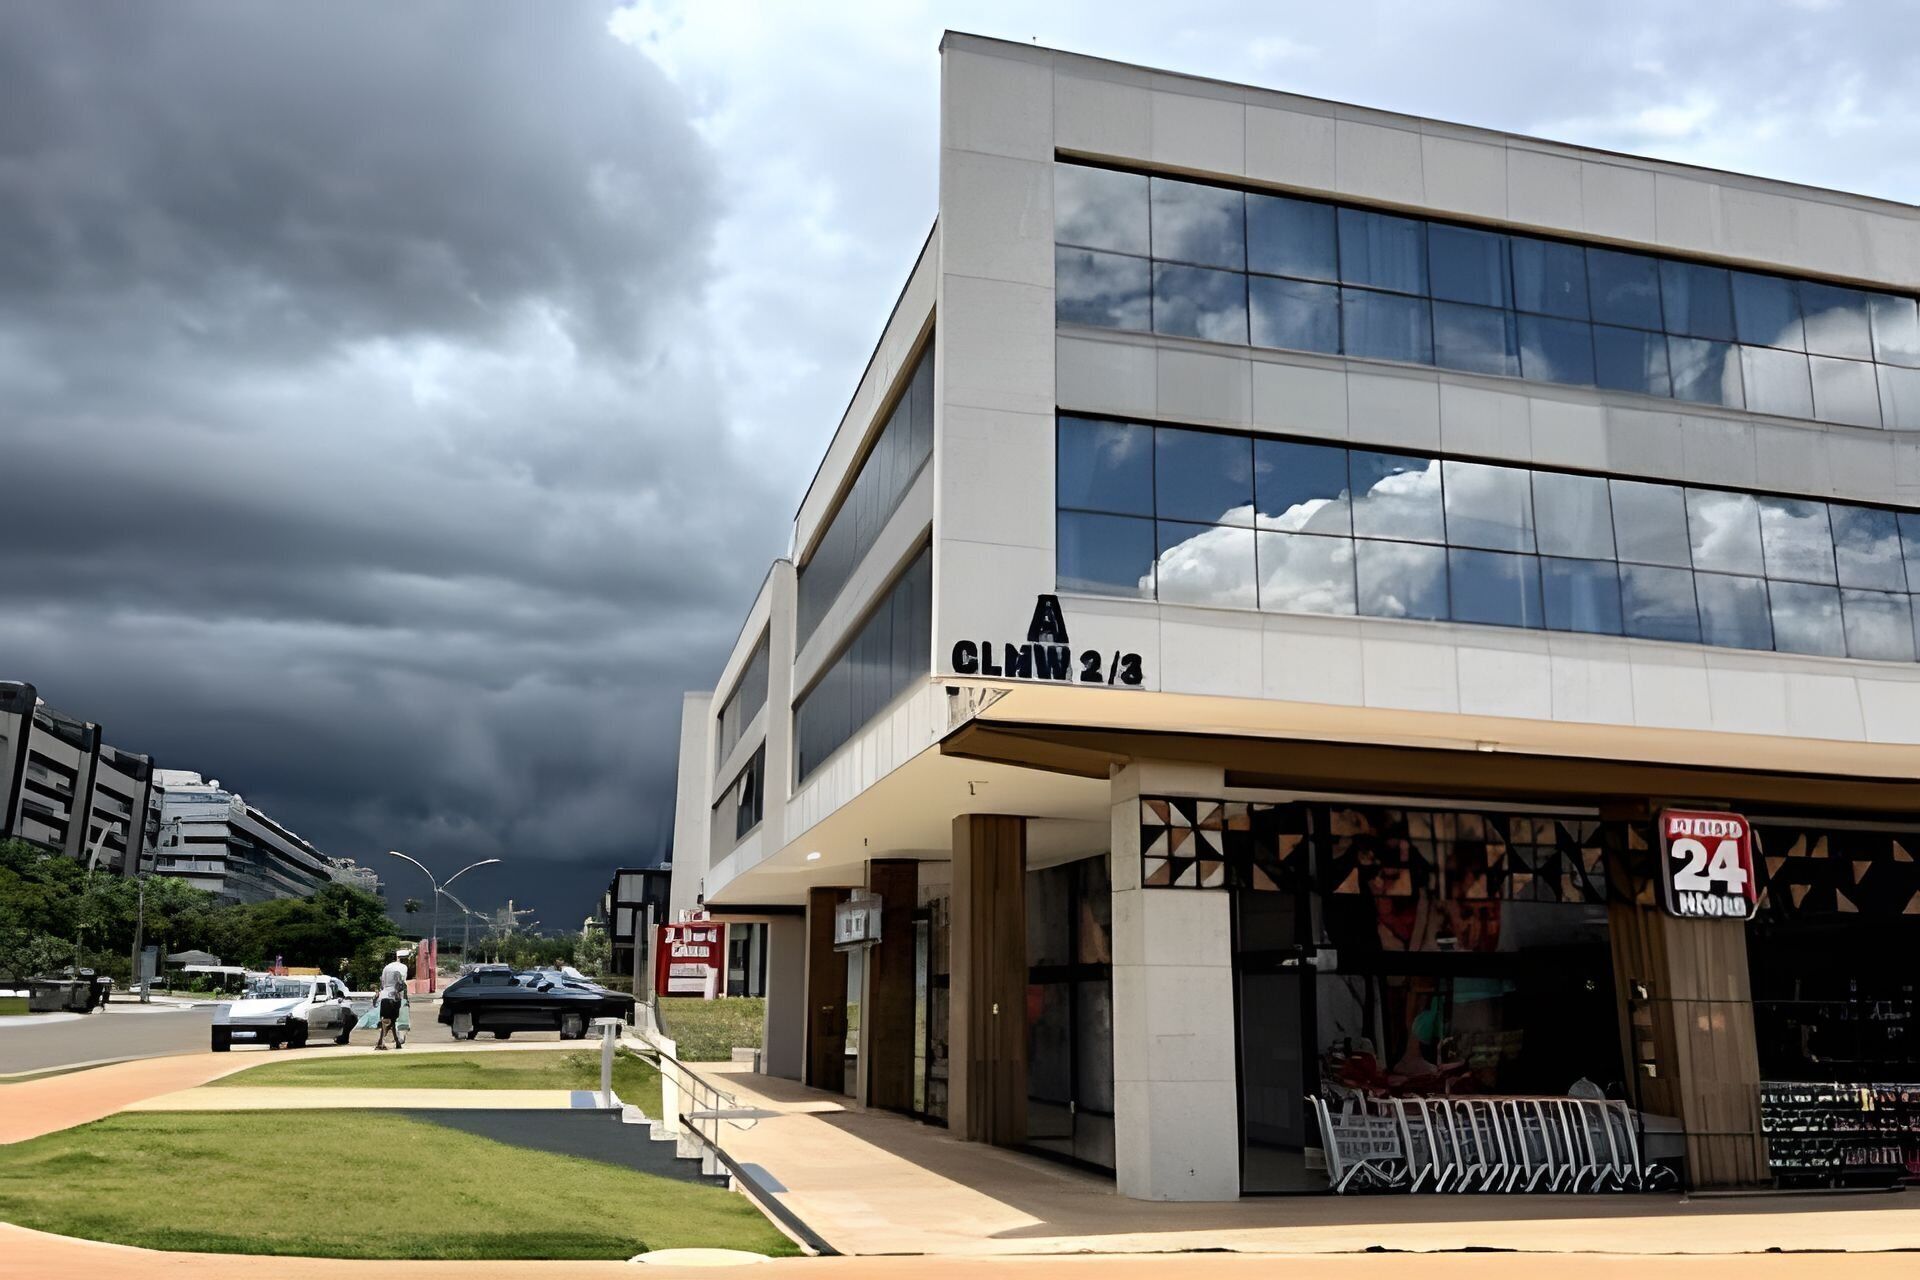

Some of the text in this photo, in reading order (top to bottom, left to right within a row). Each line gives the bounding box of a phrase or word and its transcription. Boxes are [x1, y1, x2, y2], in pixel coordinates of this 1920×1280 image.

[1027, 594, 1069, 643] A
[1080, 650, 1143, 685] 2/3
[1671, 838, 1747, 893] 24
